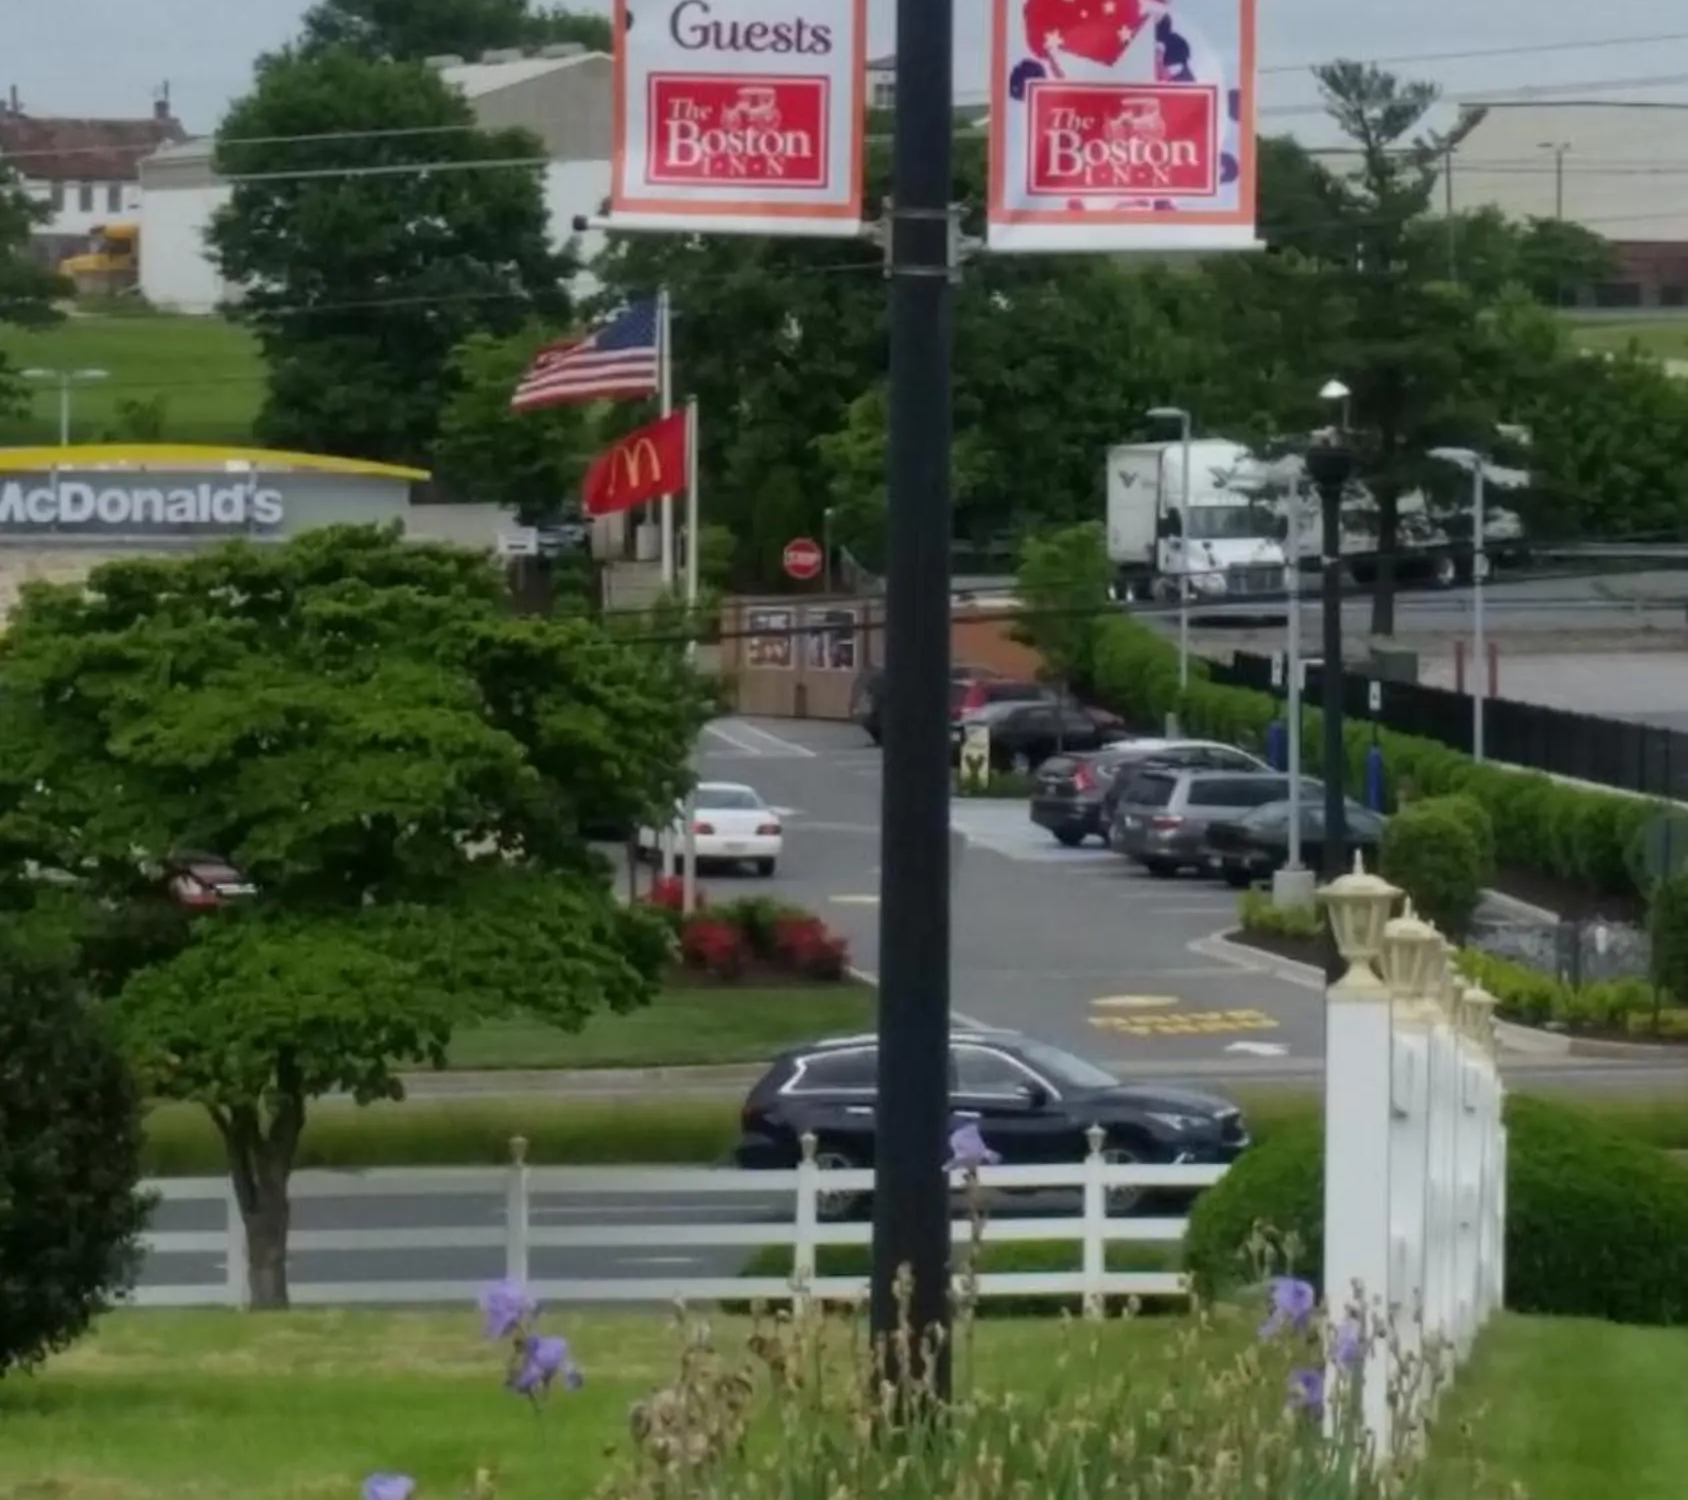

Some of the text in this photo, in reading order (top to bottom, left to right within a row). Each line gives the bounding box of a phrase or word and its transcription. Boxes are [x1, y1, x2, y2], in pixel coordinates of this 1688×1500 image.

[667, 97, 714, 121] The
[1050, 107, 1096, 130] The
[664, 119, 813, 168] Boston
[1044, 128, 1201, 177] Boston
[0, 481, 284, 523] McDonald's
